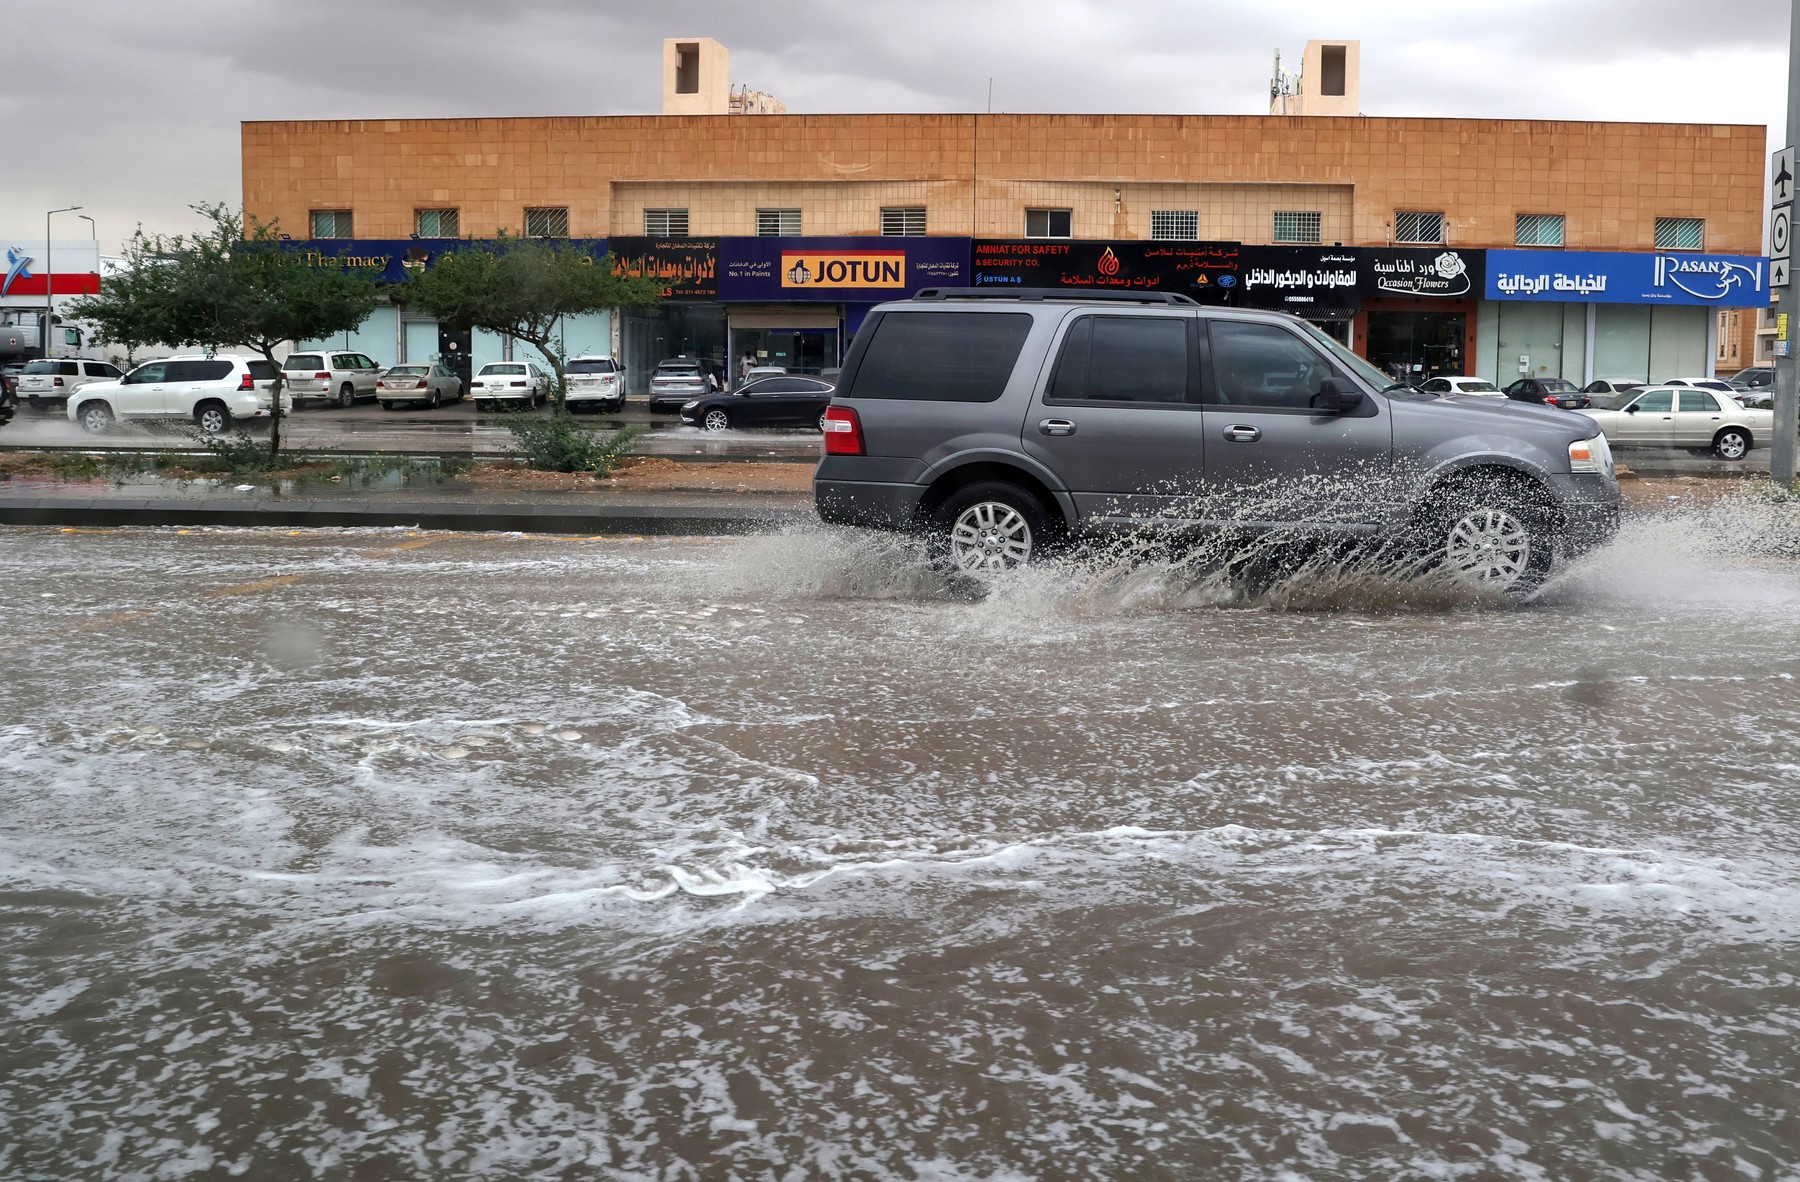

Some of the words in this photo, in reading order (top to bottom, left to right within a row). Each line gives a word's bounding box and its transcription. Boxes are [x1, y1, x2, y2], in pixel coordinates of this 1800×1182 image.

[976, 245, 1010, 254] AMNIAT
[1012, 245, 1030, 254] FOR
[1032, 245, 1070, 254] SAFETY
[1208, 247, 1238, 258] شركة
[1342, 254, 1356, 262] مؤسسة
[814, 260, 900, 283] JOTUN
[1374, 259, 1415, 274] المناسبة
[1419, 264, 1435, 276] ورد
[1060, 272, 1094, 285] السلامة
[1096, 275, 1131, 287] ومعدات
[1246, 268, 1274, 290] الداخلي
[1314, 270, 1356, 289] للمقاولات
[1378, 276, 1412, 289] Occasion
[1412, 277, 1450, 292] Flowers
[1498, 273, 1550, 294] الرجالية
[1554, 274, 1606, 295] للخياطة
